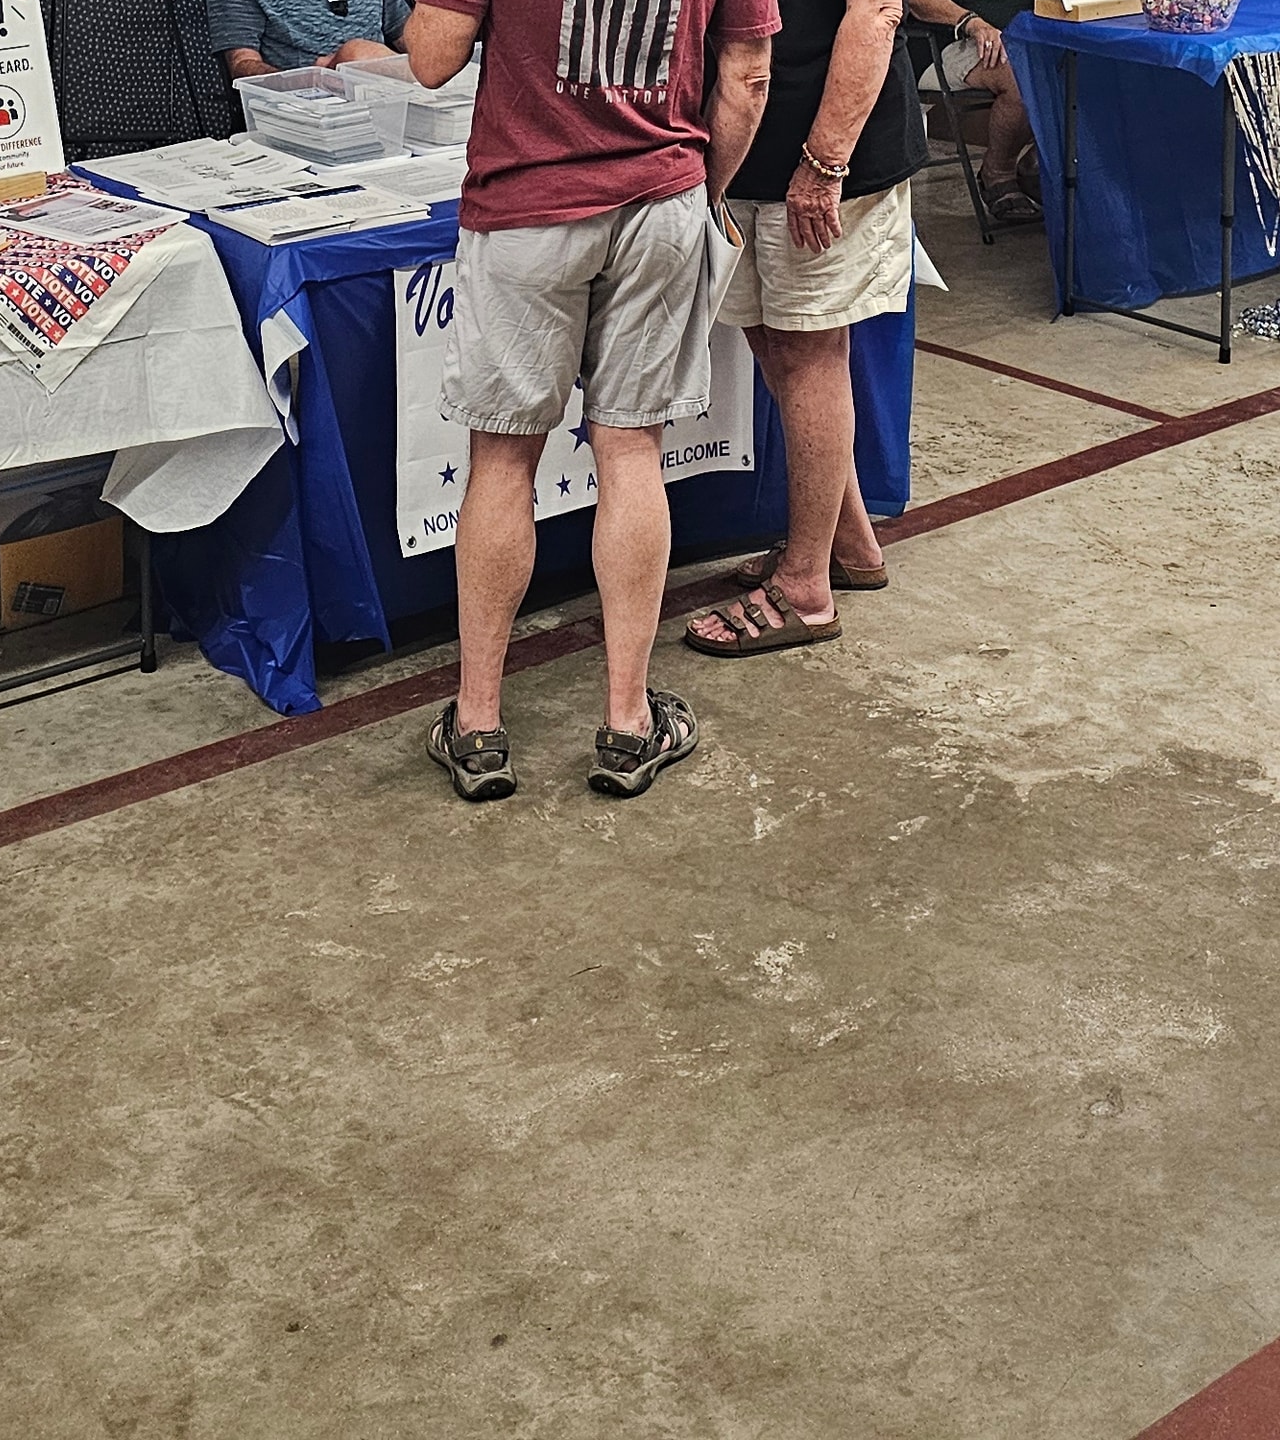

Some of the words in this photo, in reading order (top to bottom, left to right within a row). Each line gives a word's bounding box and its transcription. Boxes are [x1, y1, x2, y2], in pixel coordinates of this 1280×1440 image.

[1, 136, 42, 151] DIFFERENCE
[5, 269, 46, 300] VOTE
[66, 260, 97, 286] OTE
[41, 270, 77, 309] VOTE
[20, 295, 55, 332] VOTE
